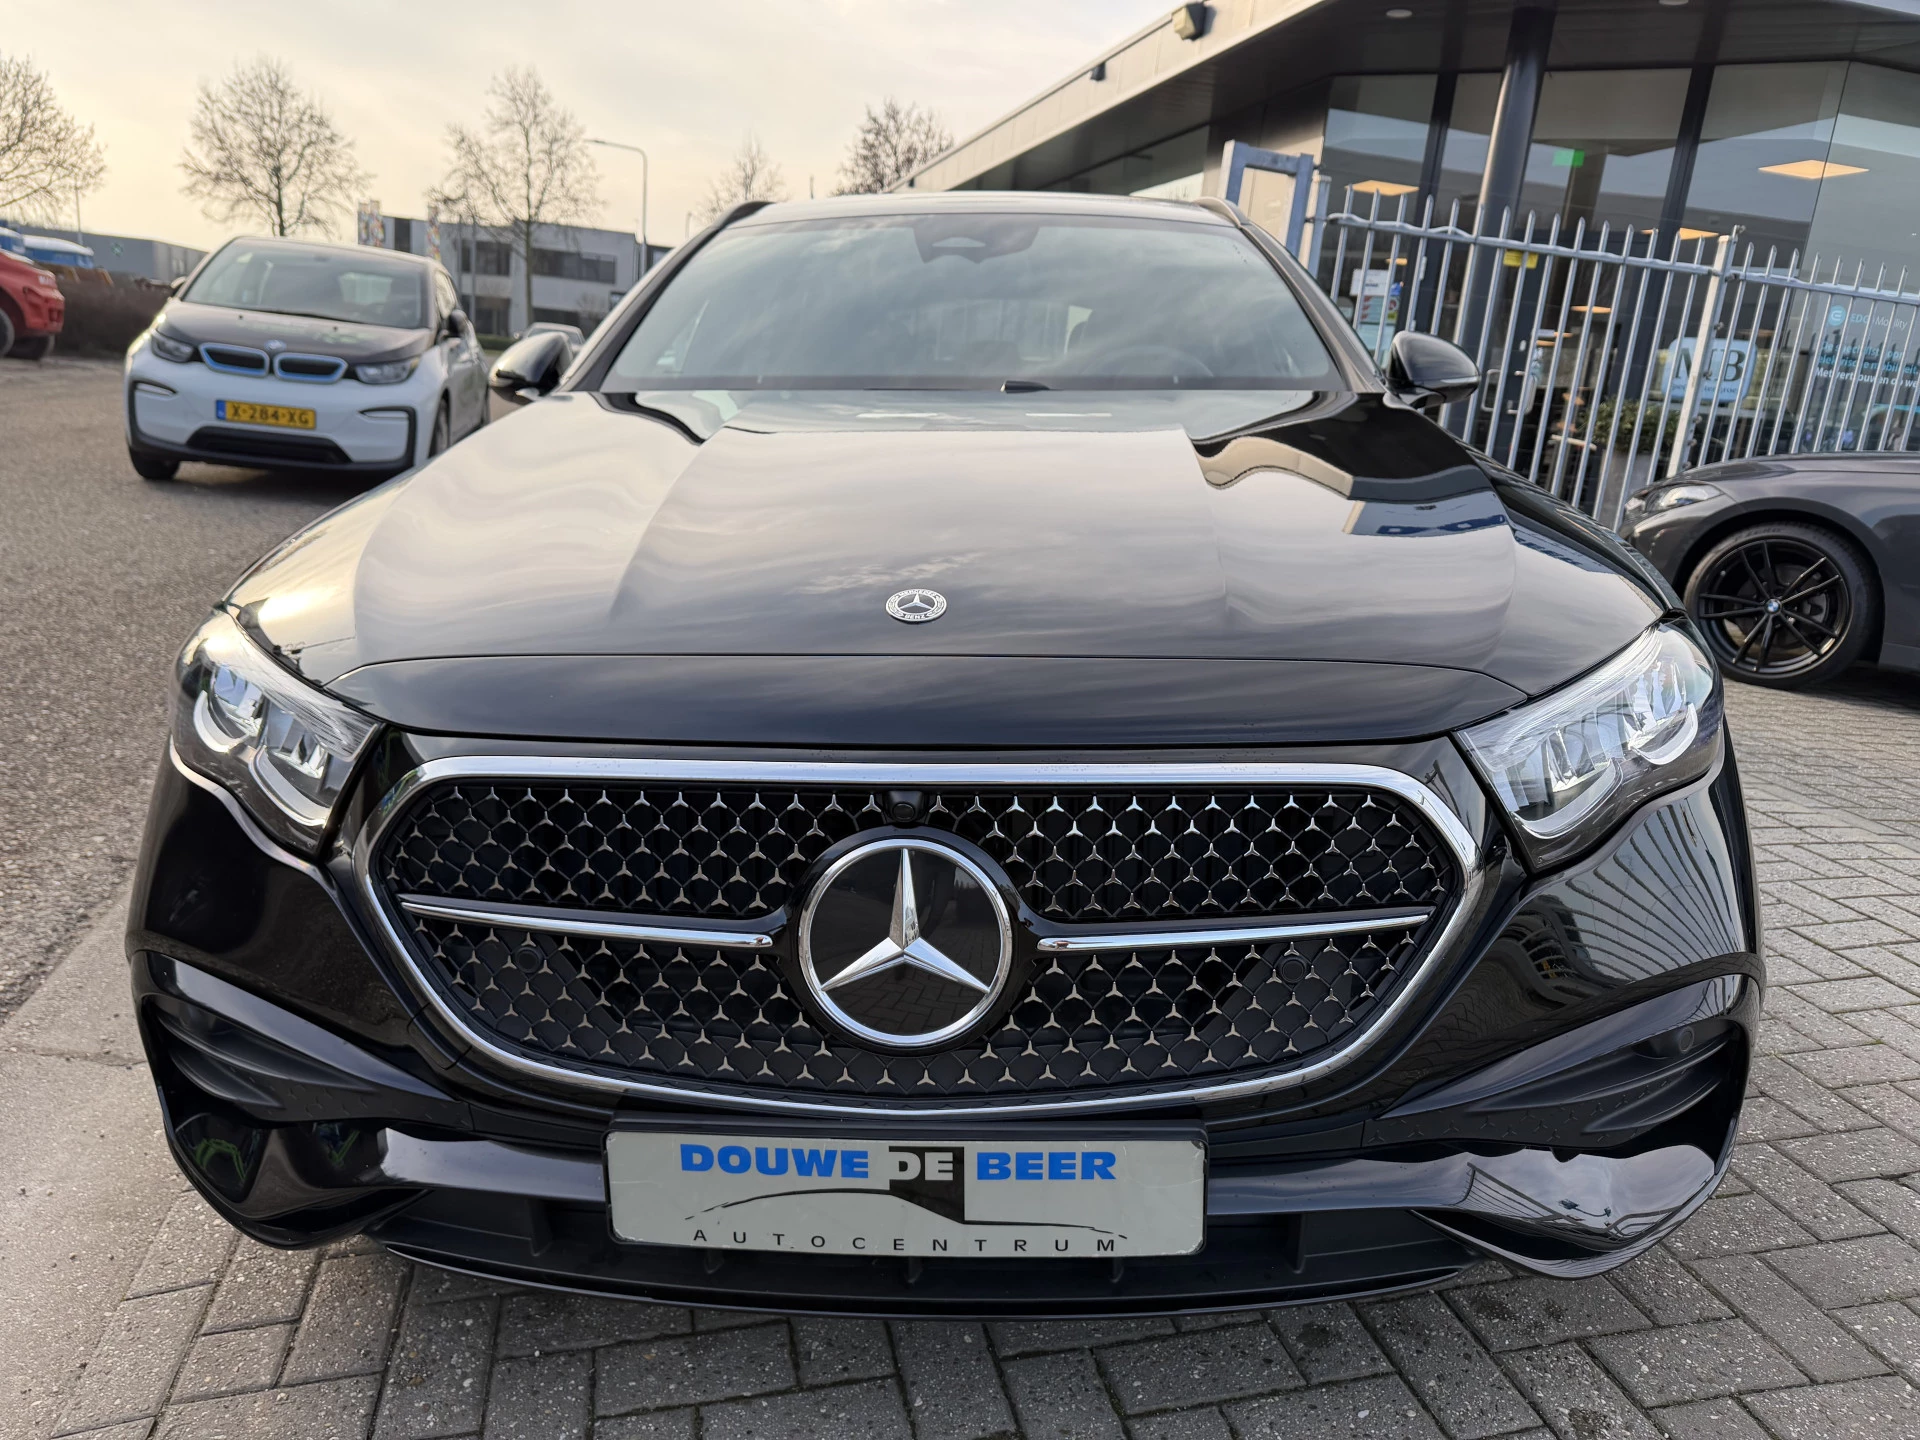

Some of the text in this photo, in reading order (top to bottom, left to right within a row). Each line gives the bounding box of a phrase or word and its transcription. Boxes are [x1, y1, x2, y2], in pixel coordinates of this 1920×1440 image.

[1816, 367, 1833, 378] Met
[680, 1143, 1117, 1181] DOUWE DE BEER
